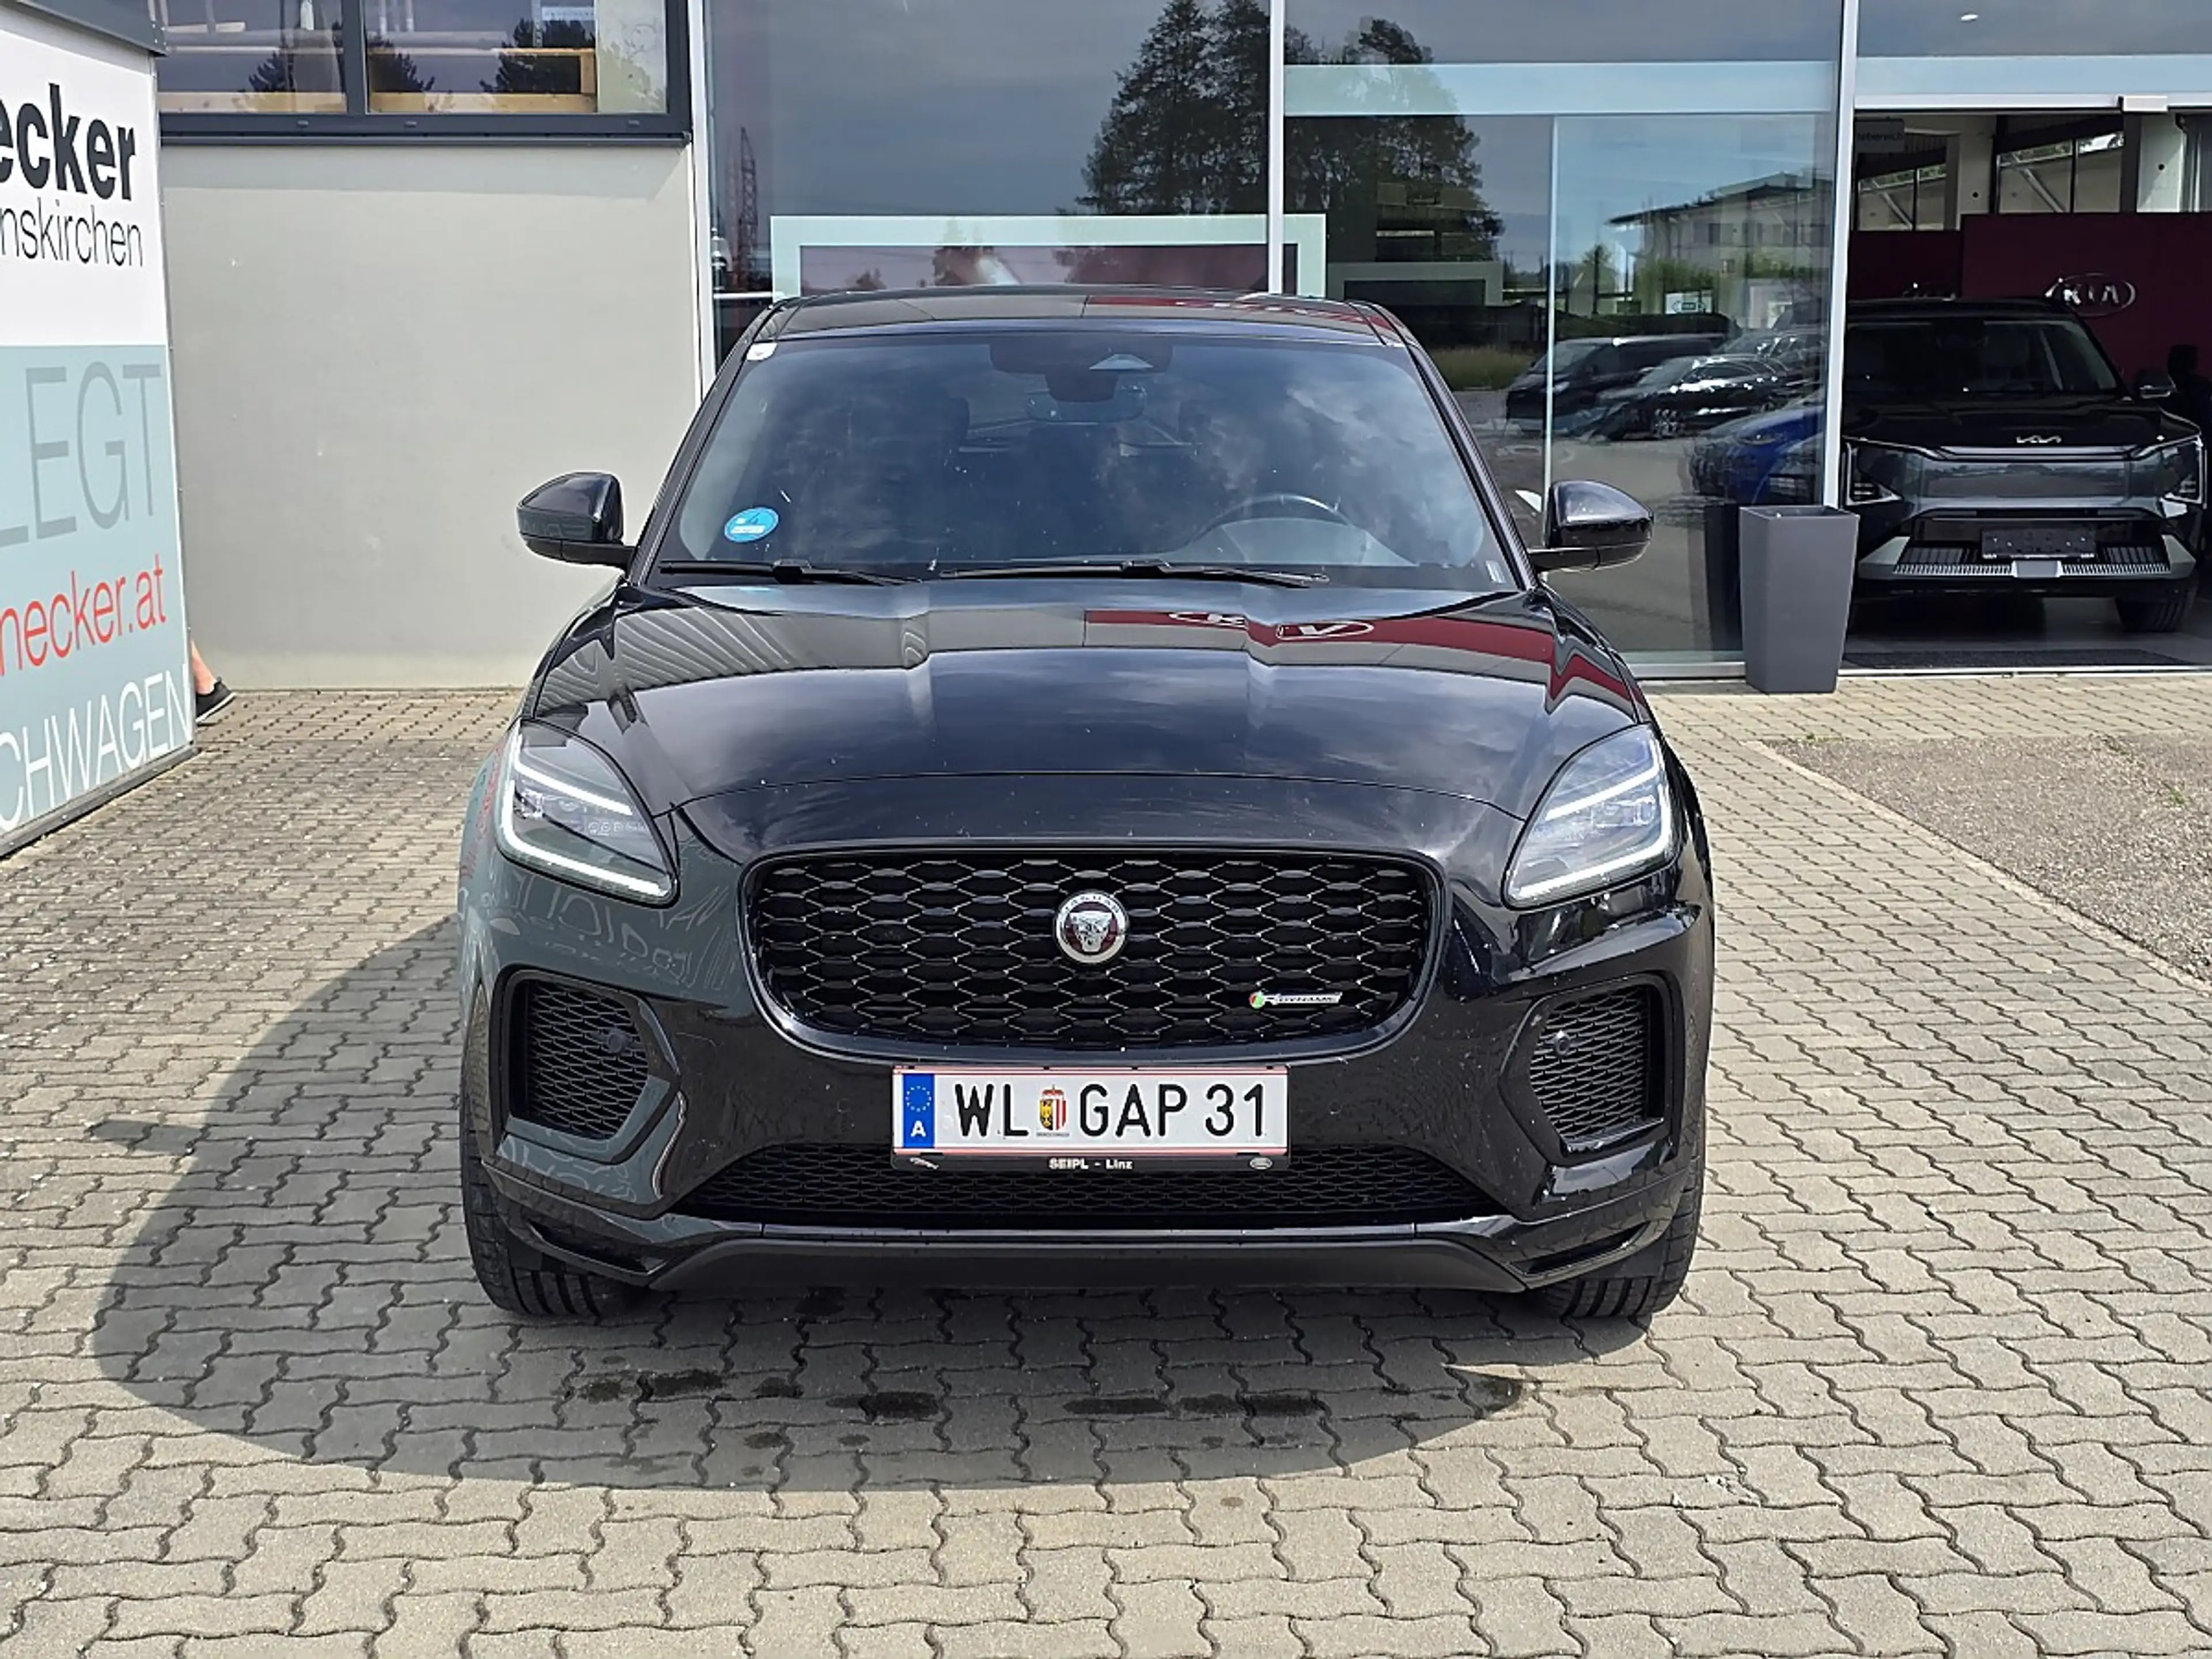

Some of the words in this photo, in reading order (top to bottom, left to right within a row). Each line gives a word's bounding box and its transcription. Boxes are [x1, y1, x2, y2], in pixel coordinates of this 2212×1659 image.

[0, 196, 143, 267] nskirchen
[2063, 284, 2119, 305] KIA
[955, 1083, 1029, 1137] WL
[1080, 1083, 1188, 1137] GAP
[1205, 1083, 1264, 1137] 31
[910, 1120, 926, 1137] A
[1048, 1157, 1089, 1170] SEIPL
[1105, 1158, 1133, 1170] Linz
